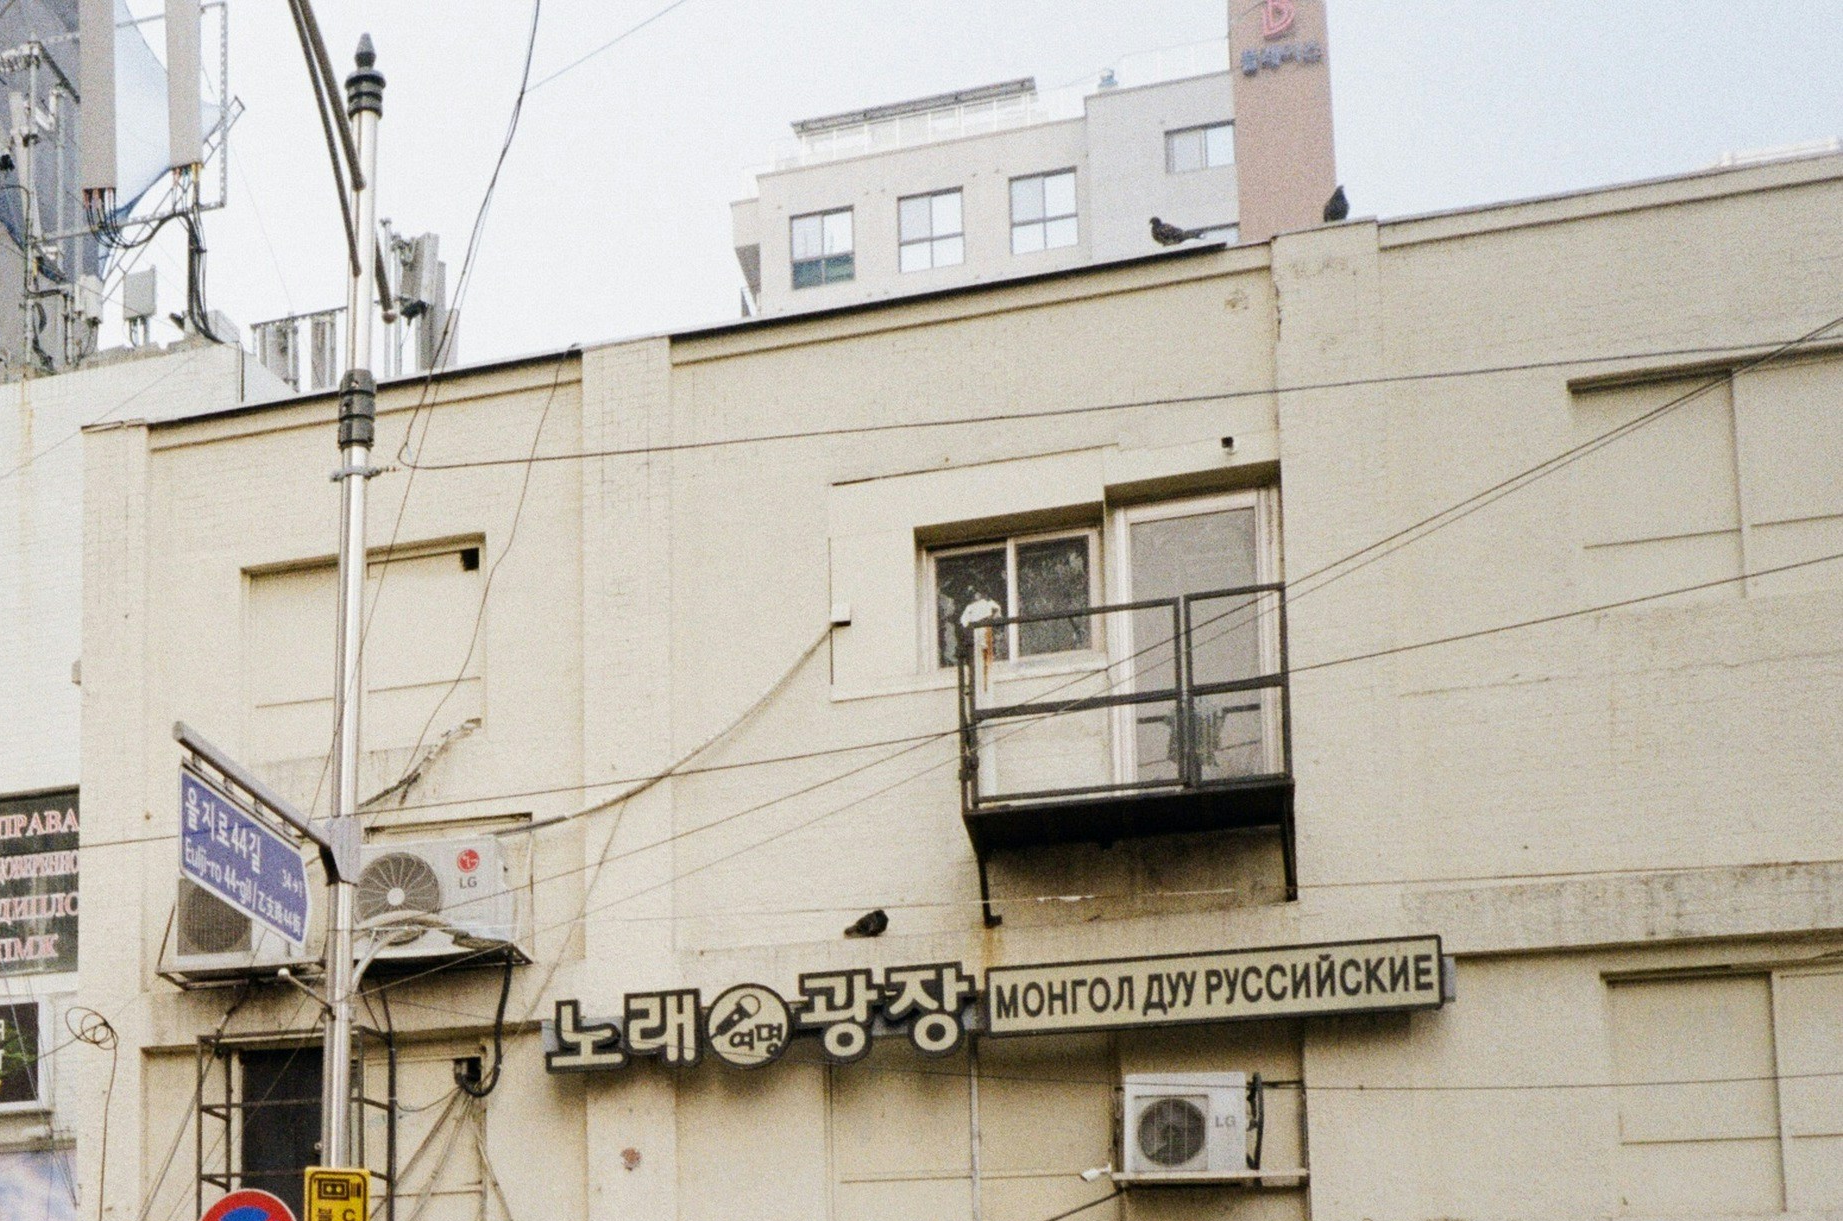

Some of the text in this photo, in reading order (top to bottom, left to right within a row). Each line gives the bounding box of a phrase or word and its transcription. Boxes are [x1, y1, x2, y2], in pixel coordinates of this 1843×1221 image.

[185, 786, 261, 875] 을지로44길
[458, 879, 478, 890] LG
[548, 966, 973, 1067] 노래 여명 광장
[994, 952, 1435, 1020] МОНГОЛ ДУУ РУССИЙСКИЕ
